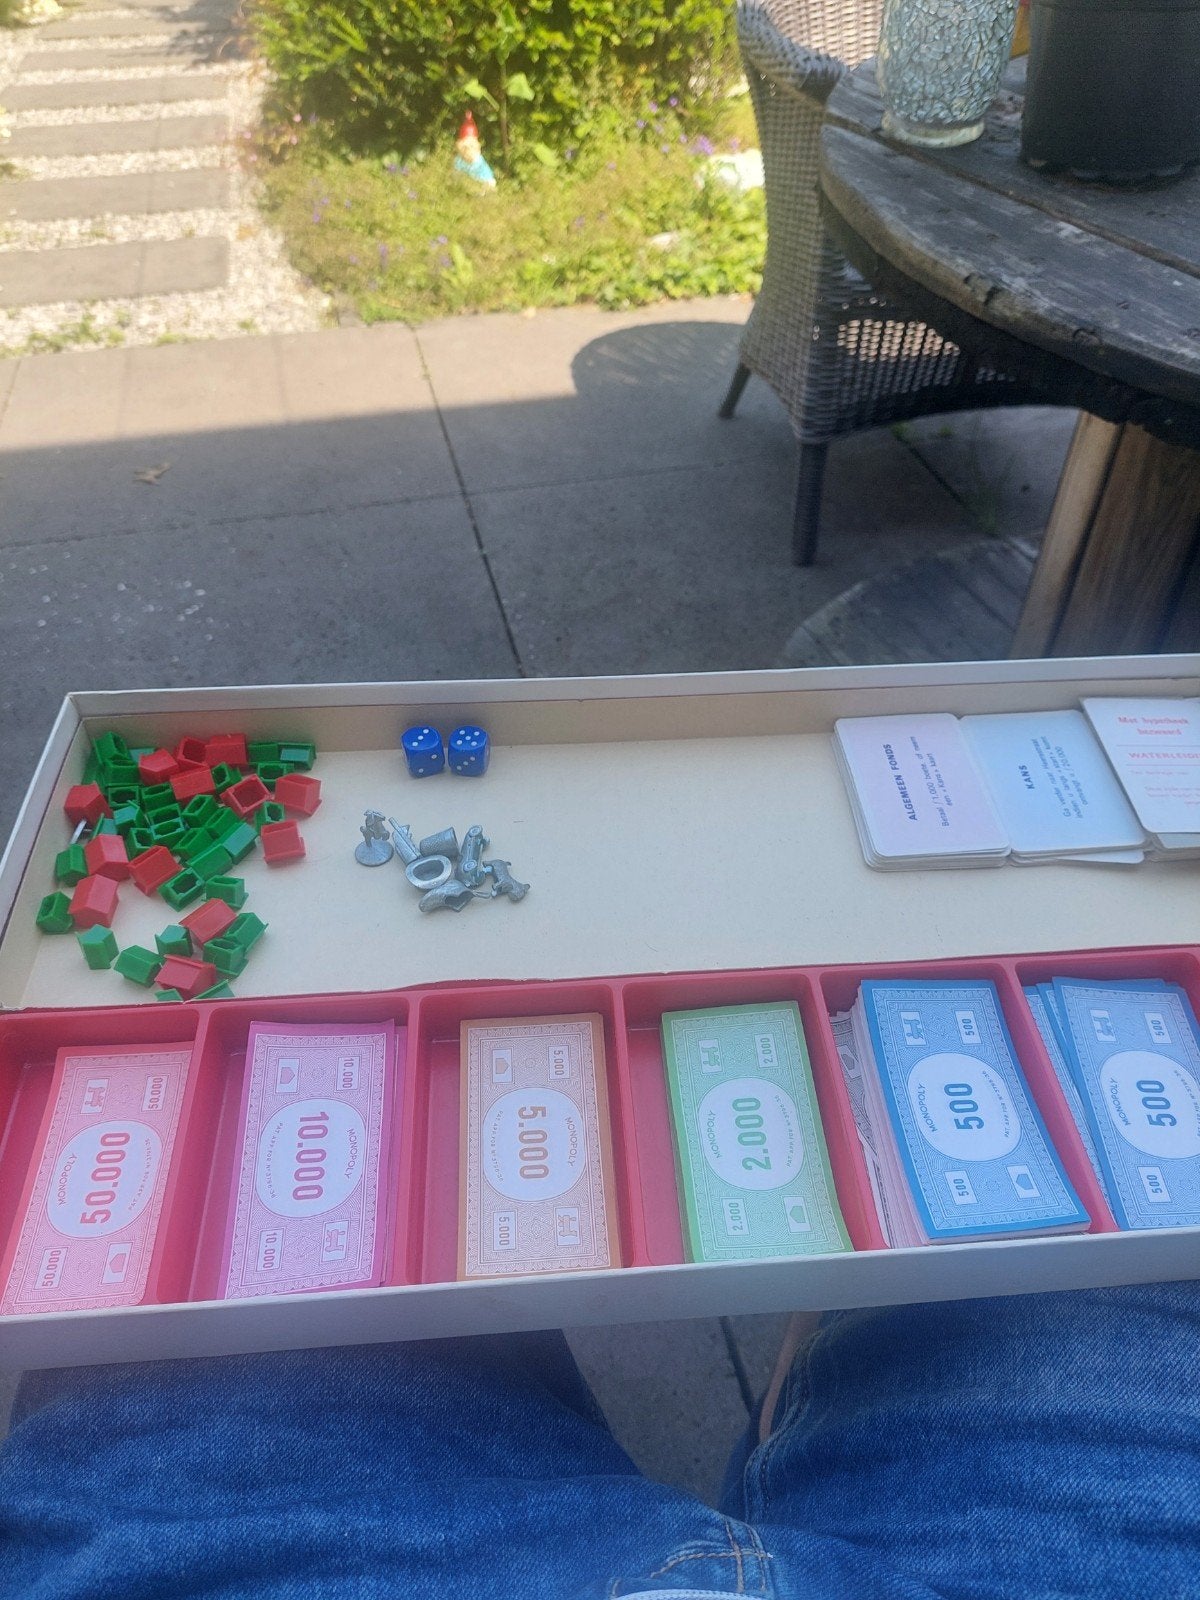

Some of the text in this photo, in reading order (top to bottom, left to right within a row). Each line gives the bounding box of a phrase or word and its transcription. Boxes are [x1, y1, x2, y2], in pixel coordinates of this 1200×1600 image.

[883, 744, 918, 820] ALGEMEEN FONDS
[1019, 765, 1035, 789] KANS
[961, 1018, 975, 1036] 500
[1151, 1019, 1165, 1037] 500
[553, 1050, 565, 1076] 5.000
[760, 1037, 774, 1065] 2.000
[148, 1077, 164, 1110] 50.000
[342, 1057, 355, 1089] 10.000
[917, 1083, 938, 1133] MONOPOLY
[943, 1083, 985, 1130] 500
[1110, 1077, 1131, 1127] MONOPOLY
[1136, 1079, 1177, 1127] 500
[344, 1128, 358, 1180] MONOPOLY
[518, 1105, 550, 1180] 5.000
[565, 1116, 578, 1168] MONOPOLY
[706, 1110, 722, 1159] MONOPOLY
[731, 1097, 772, 1171] 2.000
[292, 1111, 330, 1201] 10.000
[58, 1153, 78, 1207] MONOPOLY
[80, 1132, 131, 1224] 50.000
[953, 1178, 970, 1197] 500
[1146, 1174, 1162, 1194] 500
[498, 1216, 510, 1246] 5.000
[728, 1202, 743, 1231] 2.000
[41, 1249, 62, 1288] 50.000
[262, 1231, 278, 1269] 10.000
